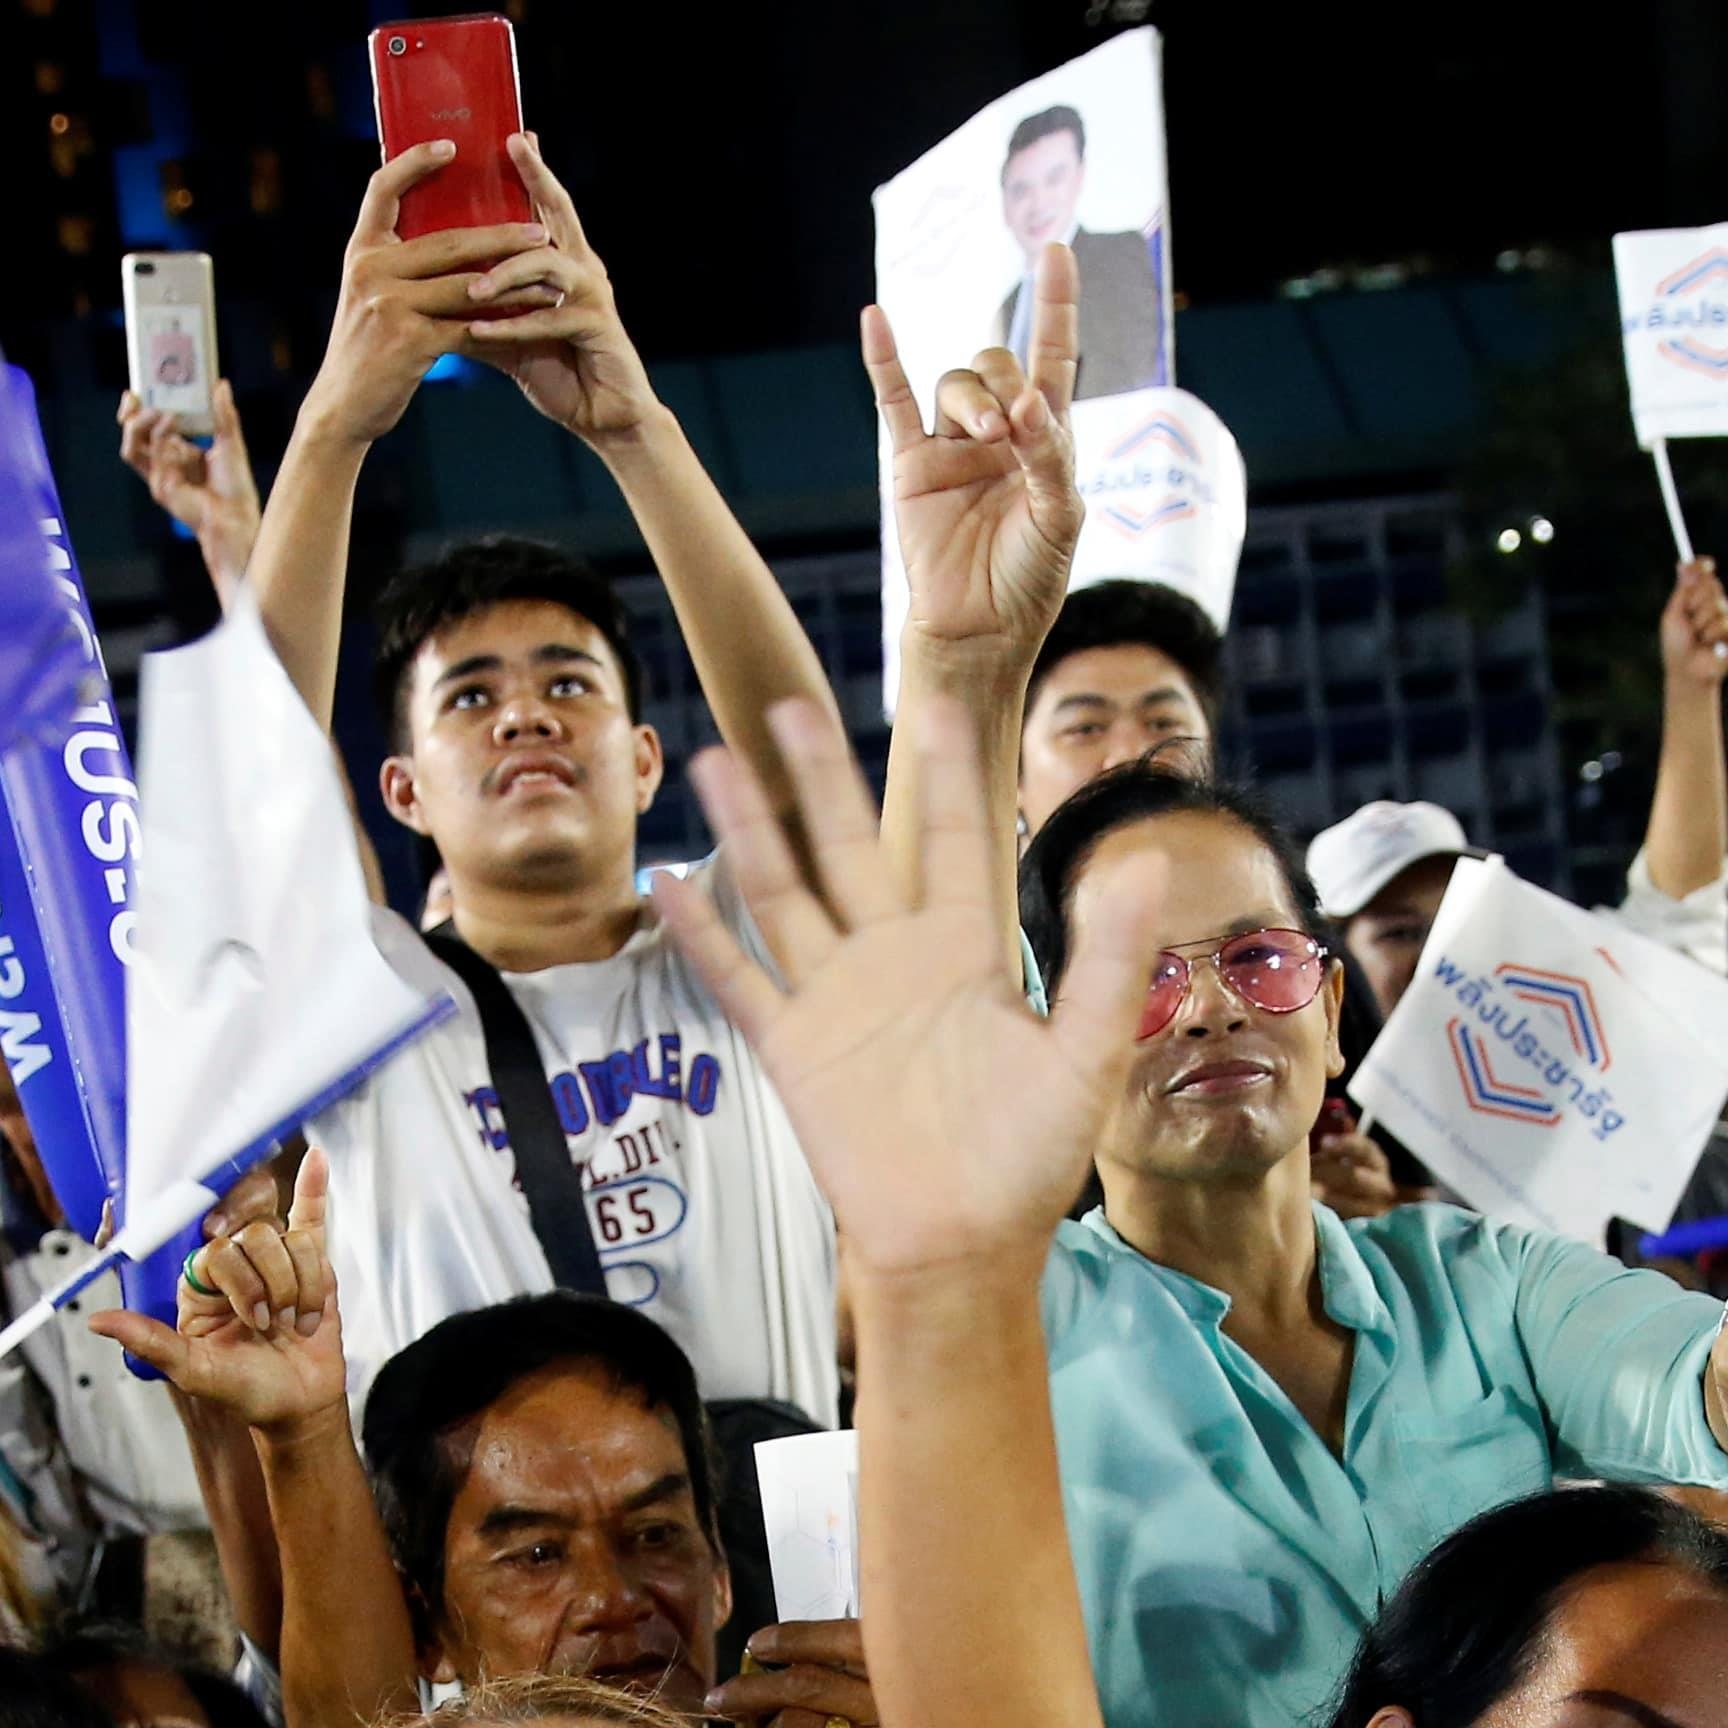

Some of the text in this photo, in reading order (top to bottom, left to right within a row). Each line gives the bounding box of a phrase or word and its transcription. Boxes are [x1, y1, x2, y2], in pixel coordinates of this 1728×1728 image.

[1434, 956, 1626, 1143] พลังประชารัฐ
